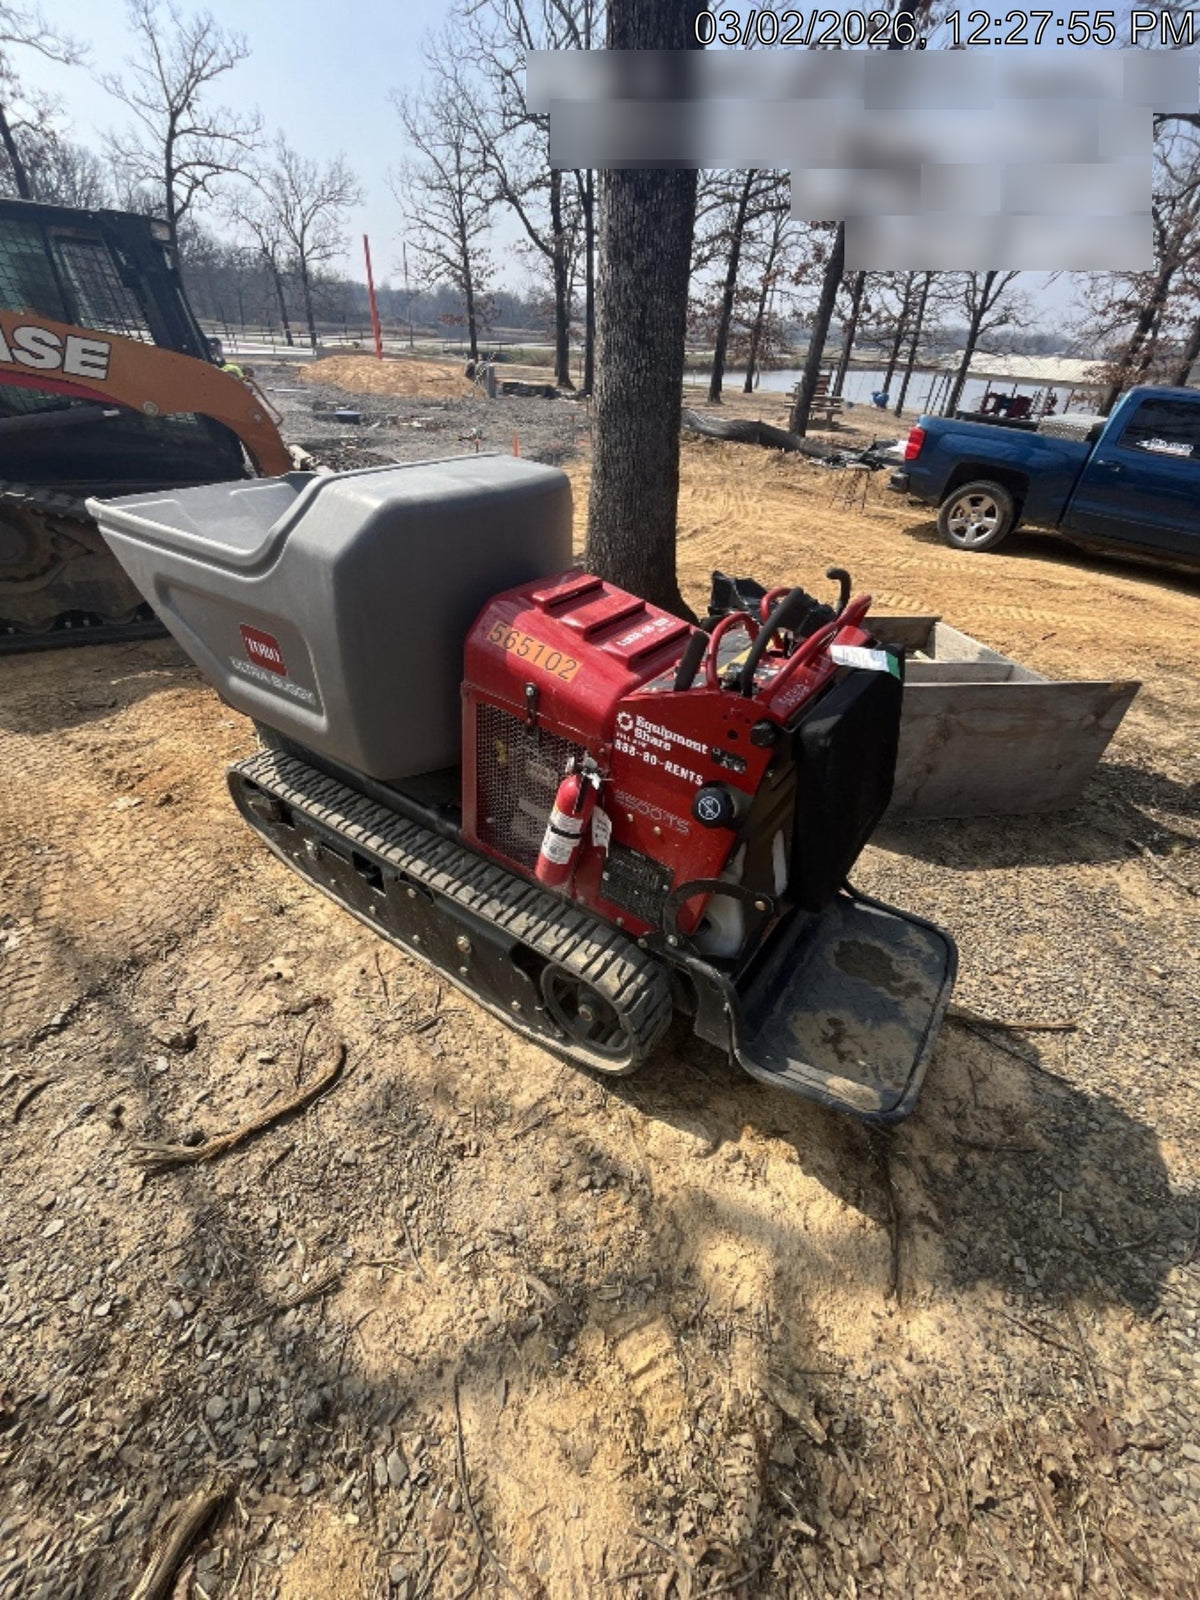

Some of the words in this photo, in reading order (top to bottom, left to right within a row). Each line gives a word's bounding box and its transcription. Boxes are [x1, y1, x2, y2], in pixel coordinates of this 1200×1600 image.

[489, 619, 578, 680] 565102
[633, 726, 672, 752] Share
[634, 714, 709, 755] Equipment
